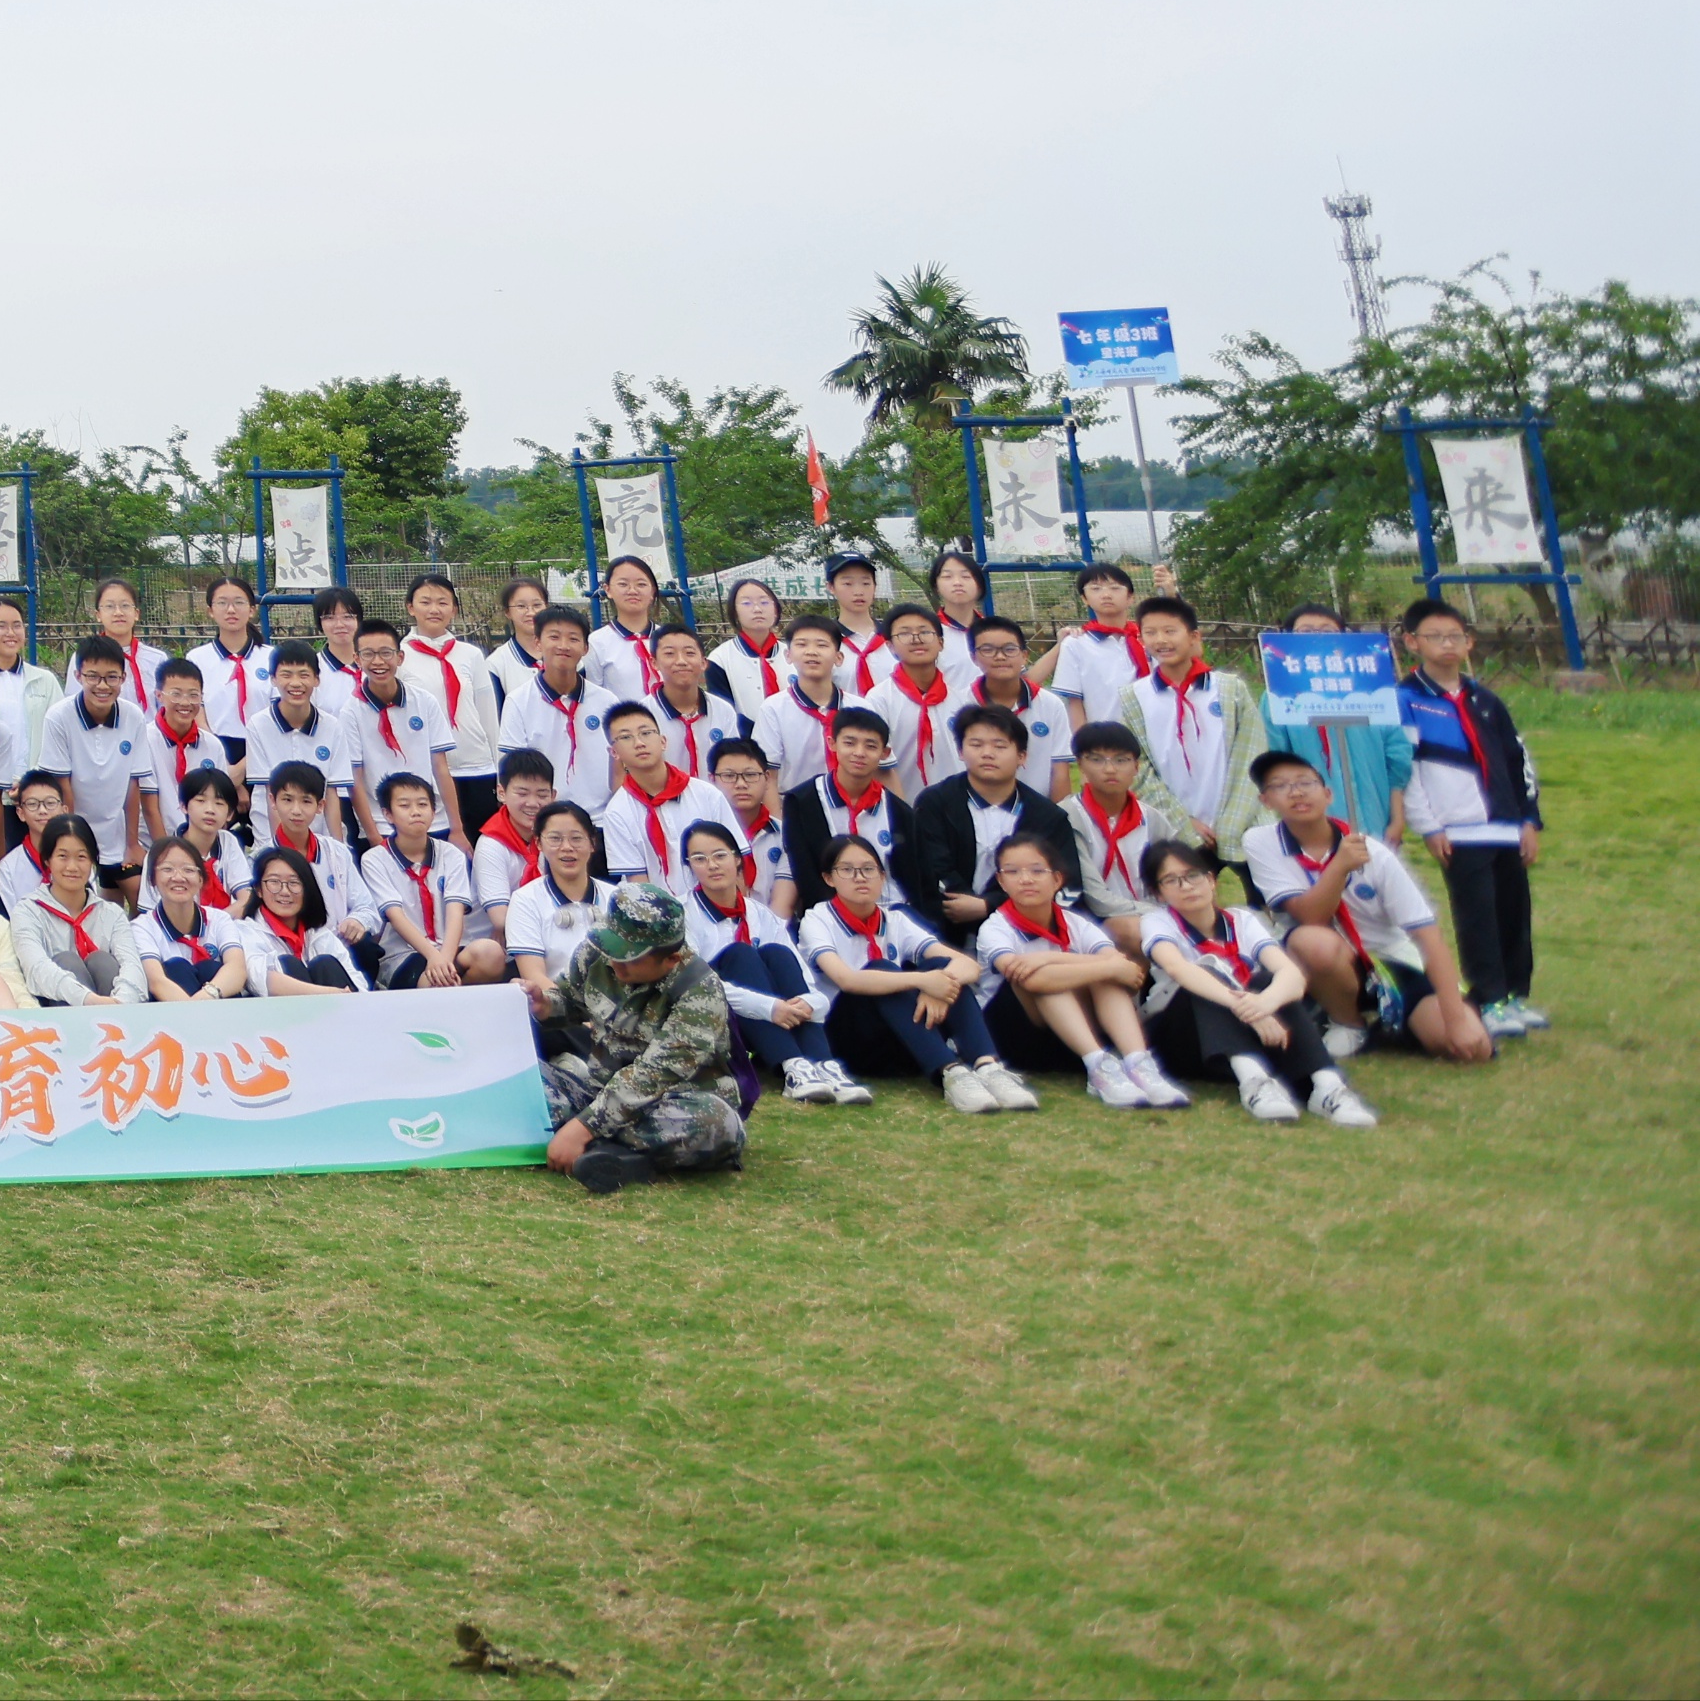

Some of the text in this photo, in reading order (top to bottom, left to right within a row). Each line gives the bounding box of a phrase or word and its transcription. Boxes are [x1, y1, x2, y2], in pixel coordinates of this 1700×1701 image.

[1076, 326, 1159, 345] 七年级3班
[603, 483, 664, 548] 亮
[994, 470, 1060, 532] 未
[1450, 467, 1530, 537] 来
[277, 530, 328, 580] 点
[1282, 654, 1378, 674] 七年级1班
